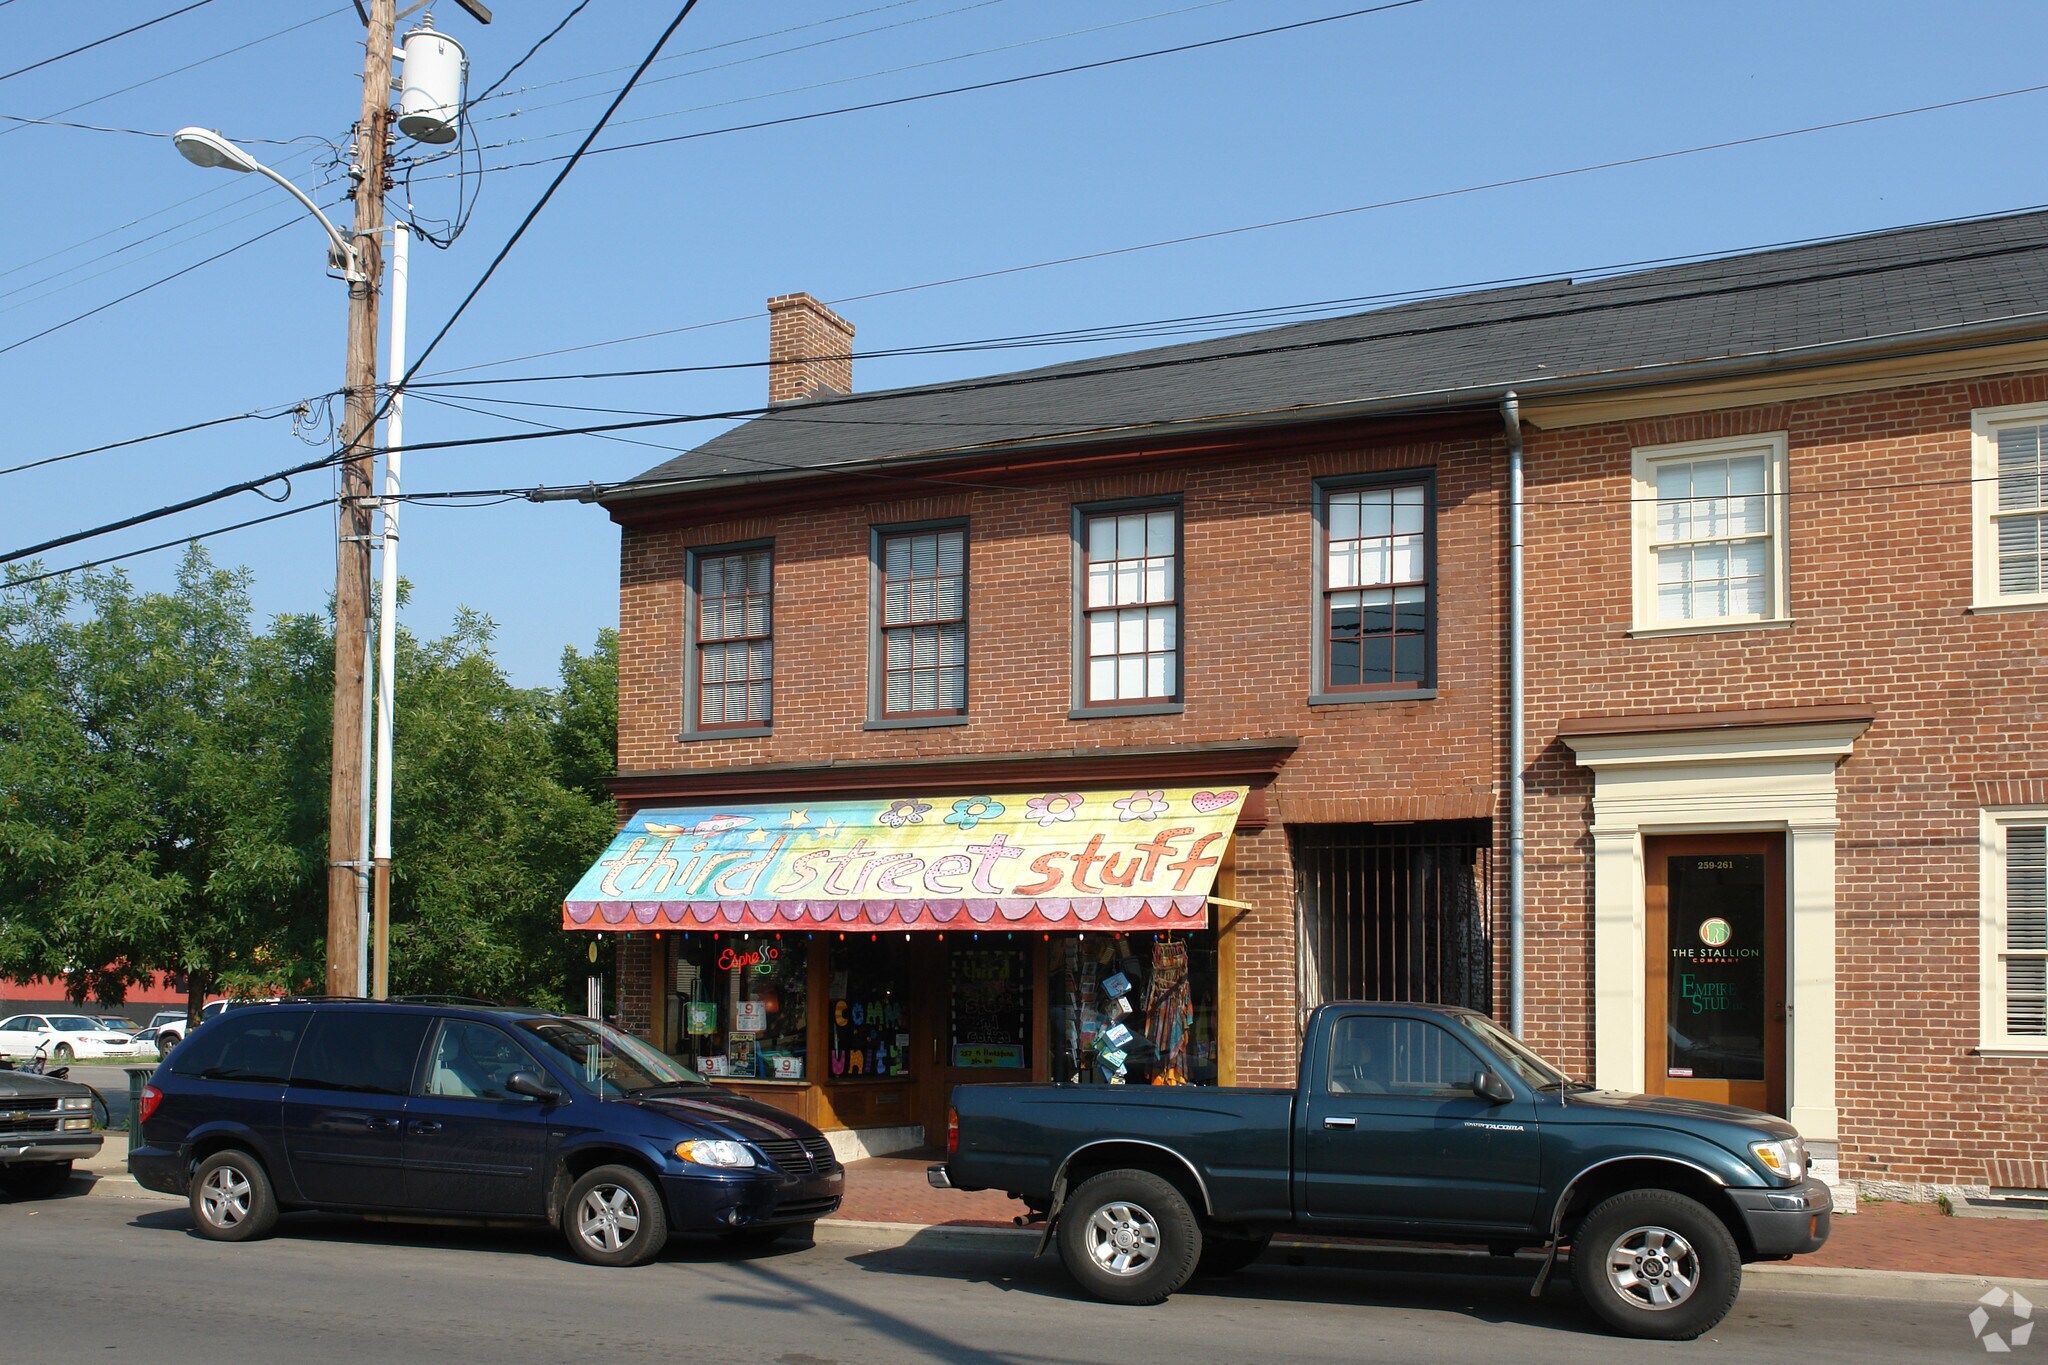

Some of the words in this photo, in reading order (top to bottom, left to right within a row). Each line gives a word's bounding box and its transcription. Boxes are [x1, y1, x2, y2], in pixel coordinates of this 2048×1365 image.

[601, 834, 787, 897] third
[773, 837, 1025, 895] street
[1013, 827, 1223, 895] stuff
[1698, 861, 1733, 870] 259-261
[1672, 948, 1694, 958] THE
[1700, 948, 1759, 958] STALLION
[718, 945, 779, 974] Espresso
[1680, 973, 1736, 998] EMPIRE
[745, 1003, 753, 1014] 9
[1692, 994, 1731, 1015] STUD
[705, 1059, 714, 1070] 9
[782, 1060, 791, 1071] 9
[1484, 1123, 1524, 1132] TACOMA
